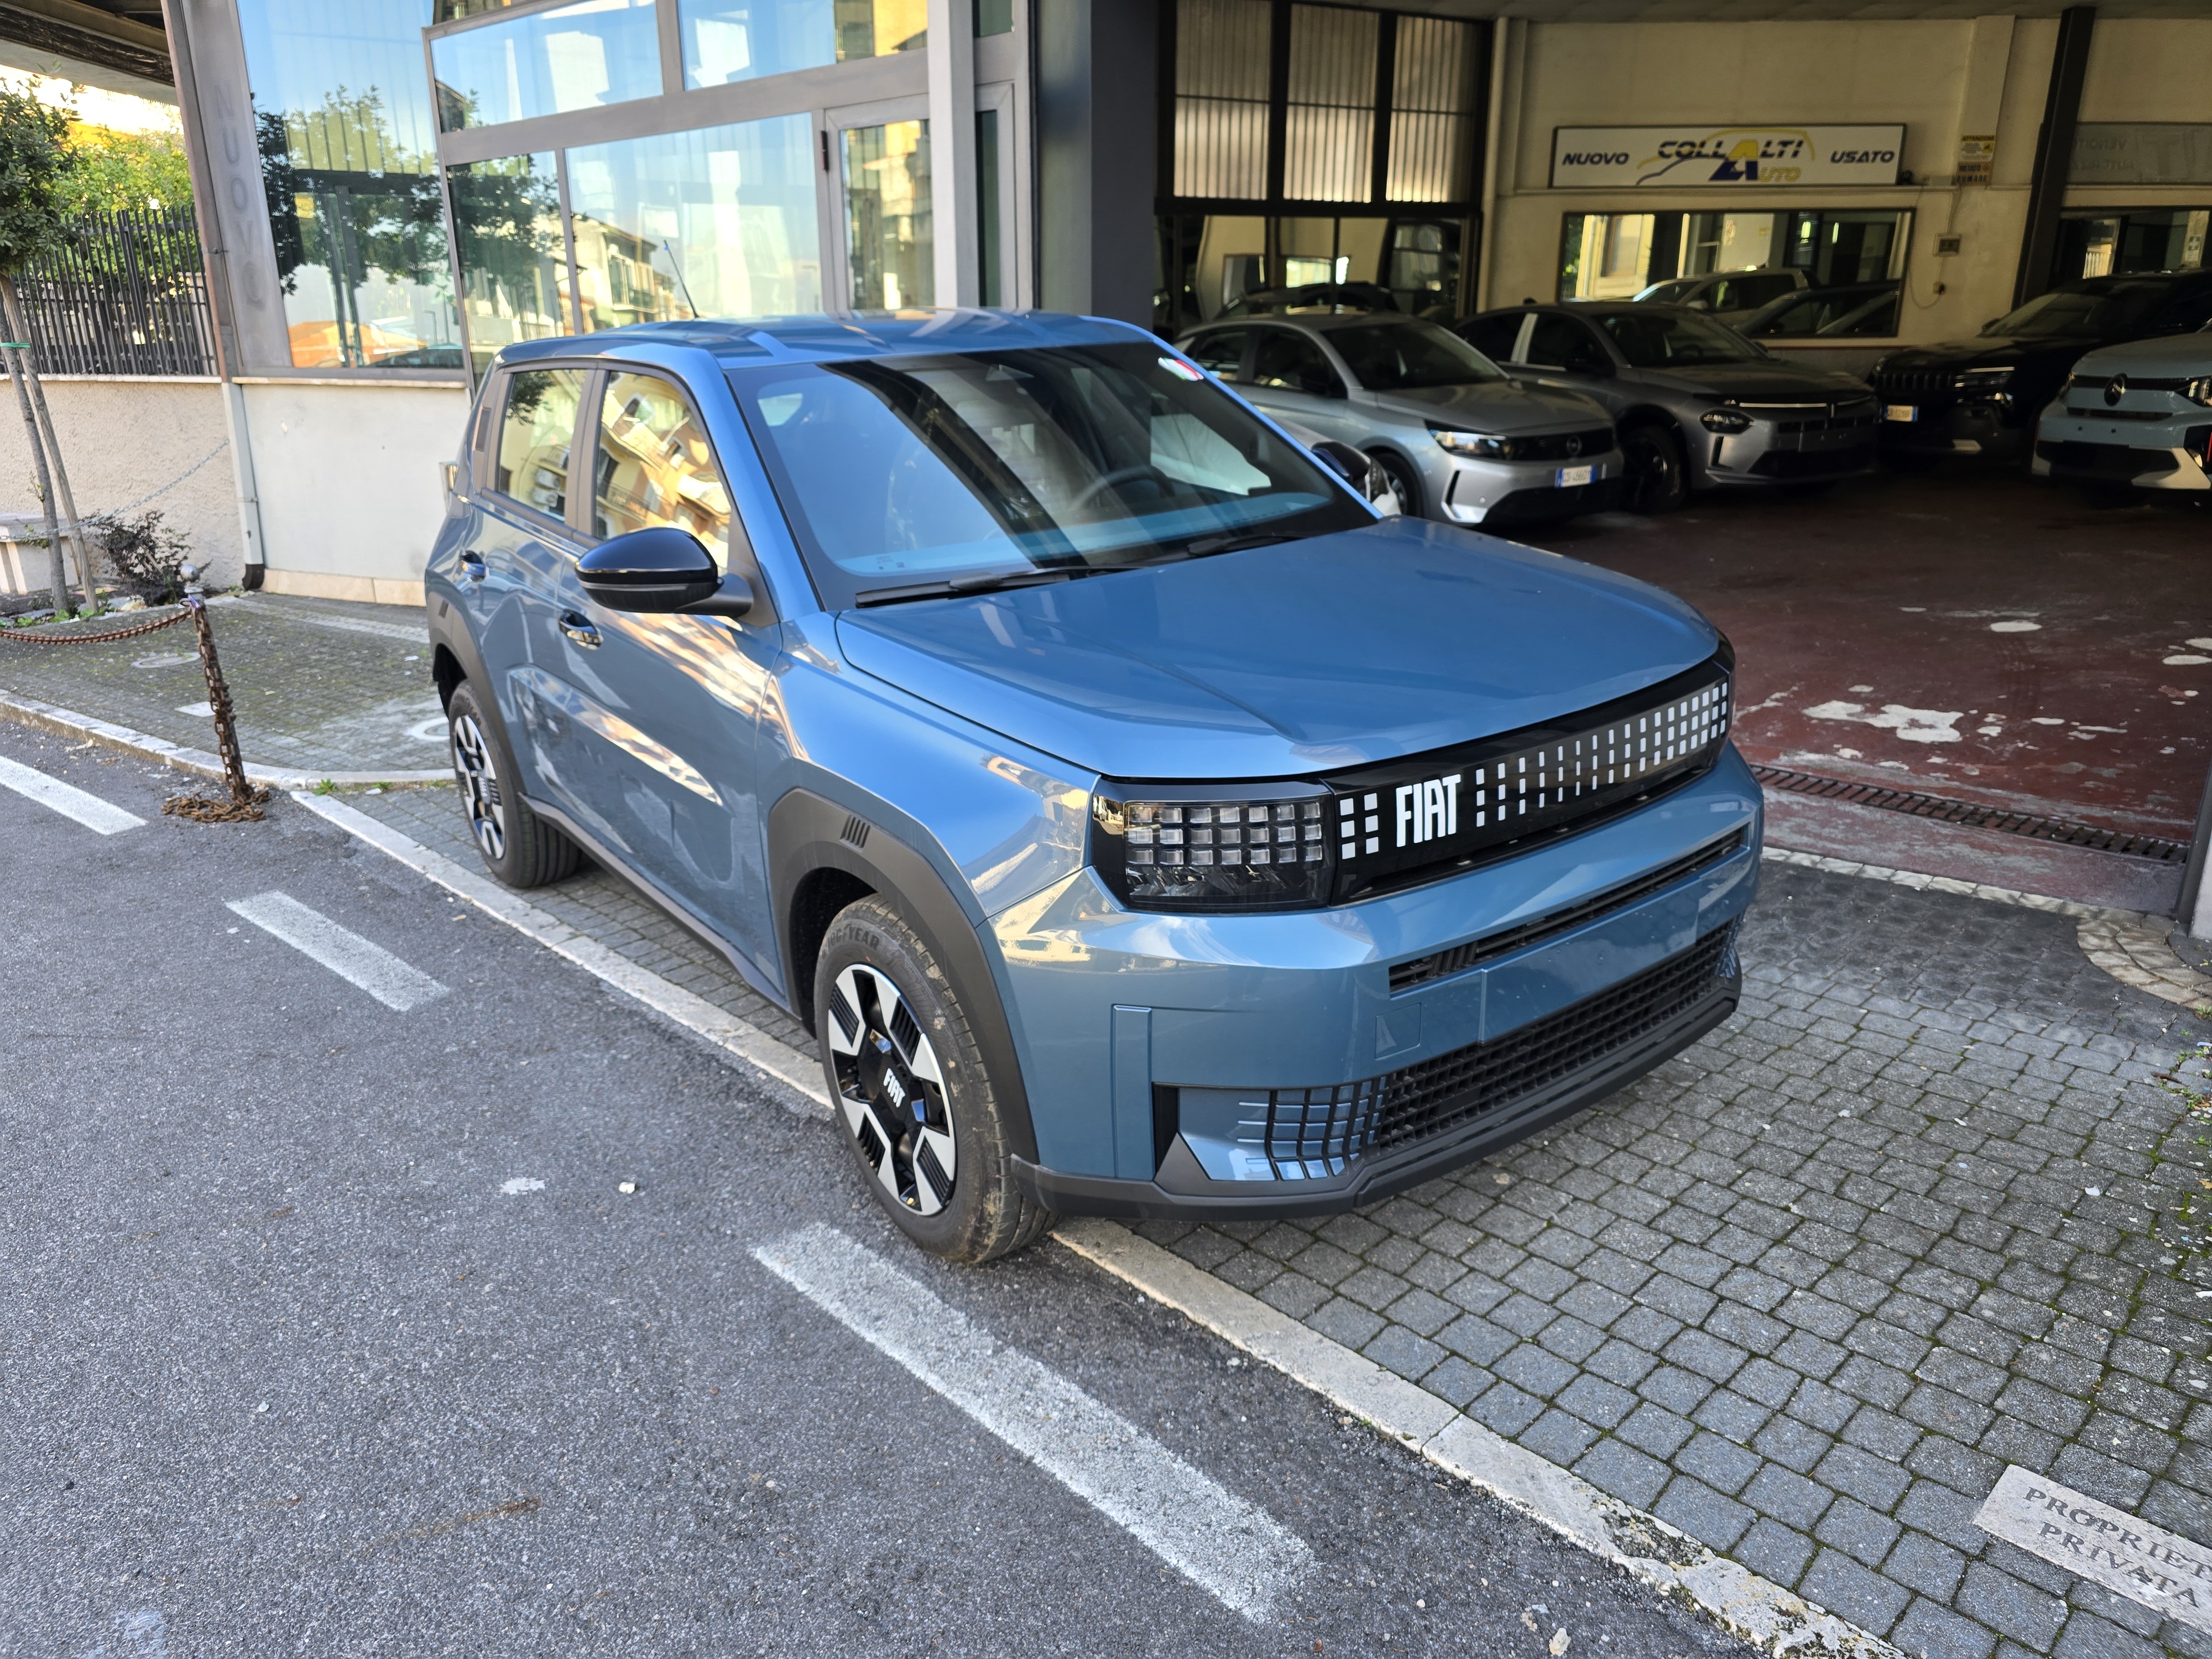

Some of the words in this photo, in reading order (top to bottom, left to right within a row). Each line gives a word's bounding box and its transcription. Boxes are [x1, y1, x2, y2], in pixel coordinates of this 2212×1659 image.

[1562, 152, 1629, 166] NUOVO
[1830, 150, 1895, 164] USATO
[213, 80, 264, 311] NUOVO
[1396, 774, 1460, 847] FIAT
[883, 1068, 906, 1108] FIAT
[2023, 1486, 2212, 1583] PROPRIET
[2038, 1521, 2199, 1608] PRIVATA
